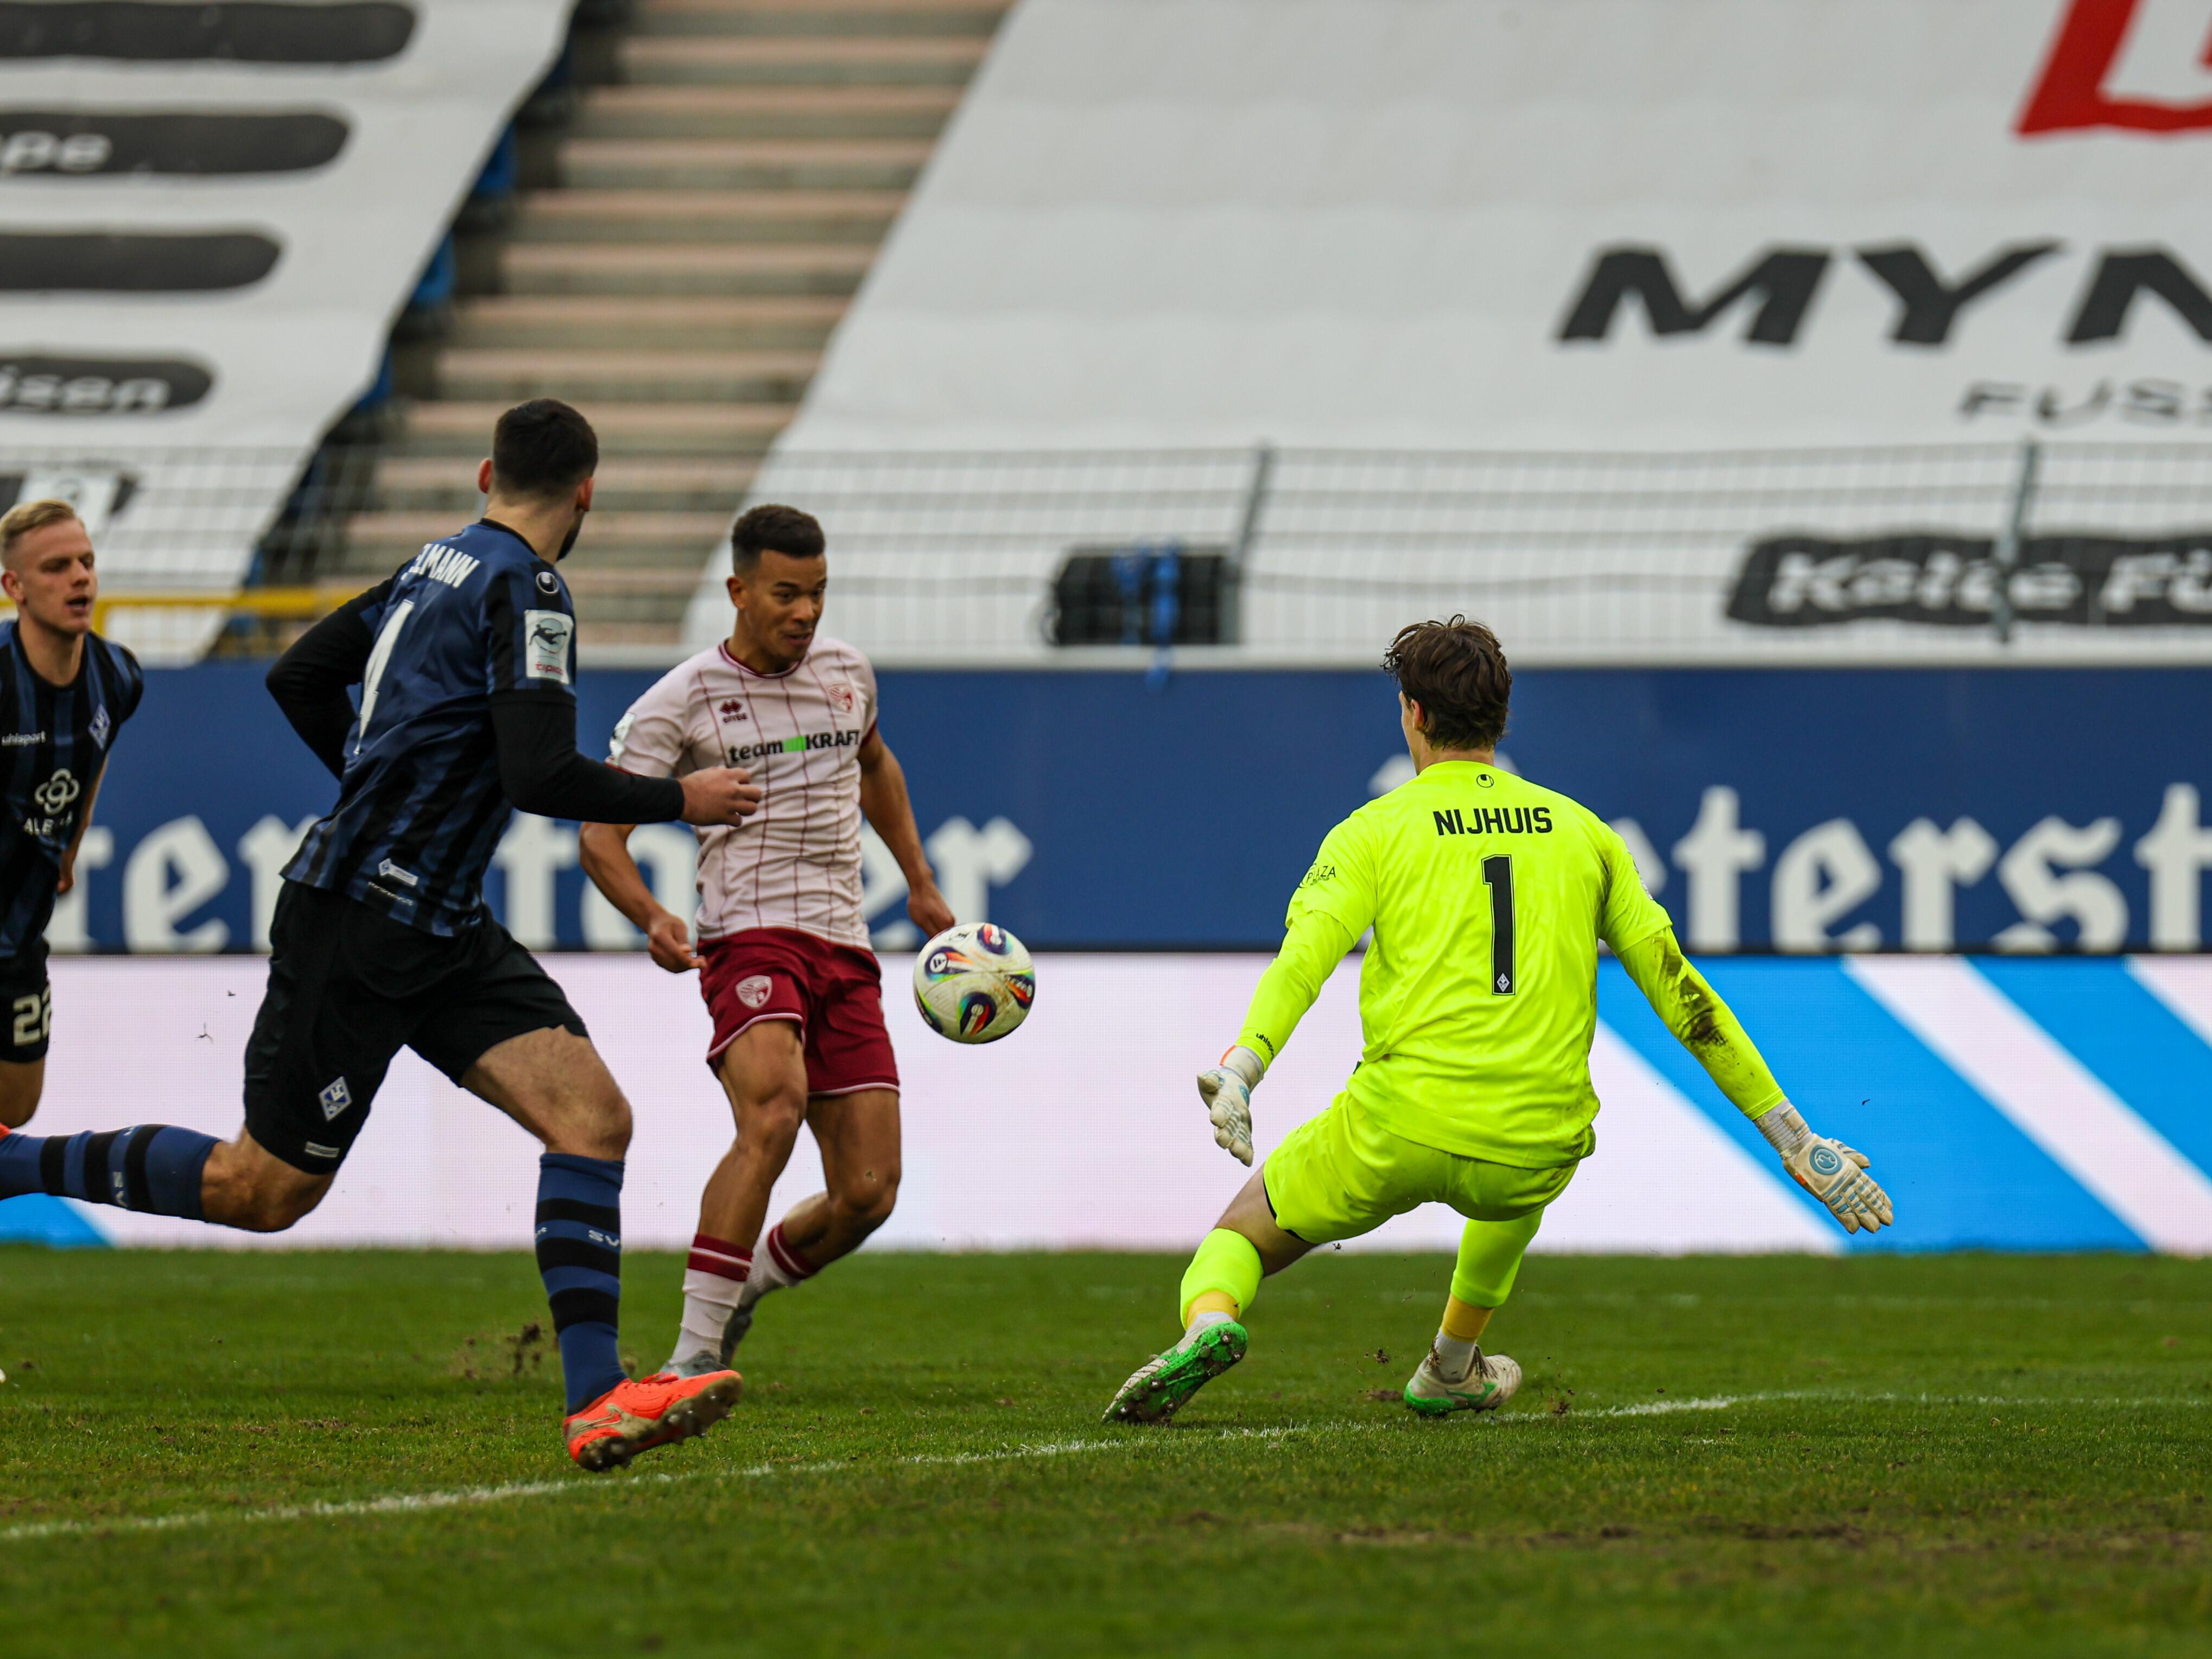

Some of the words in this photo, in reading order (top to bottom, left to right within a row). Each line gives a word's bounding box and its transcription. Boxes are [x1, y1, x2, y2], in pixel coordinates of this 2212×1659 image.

[1957, 379, 2212, 428] FUS
[729, 740, 784, 762] team
[806, 729, 860, 750] KRAFT
[1433, 806, 1552, 836] NIJHUIS
[1481, 854, 1516, 996] 1
